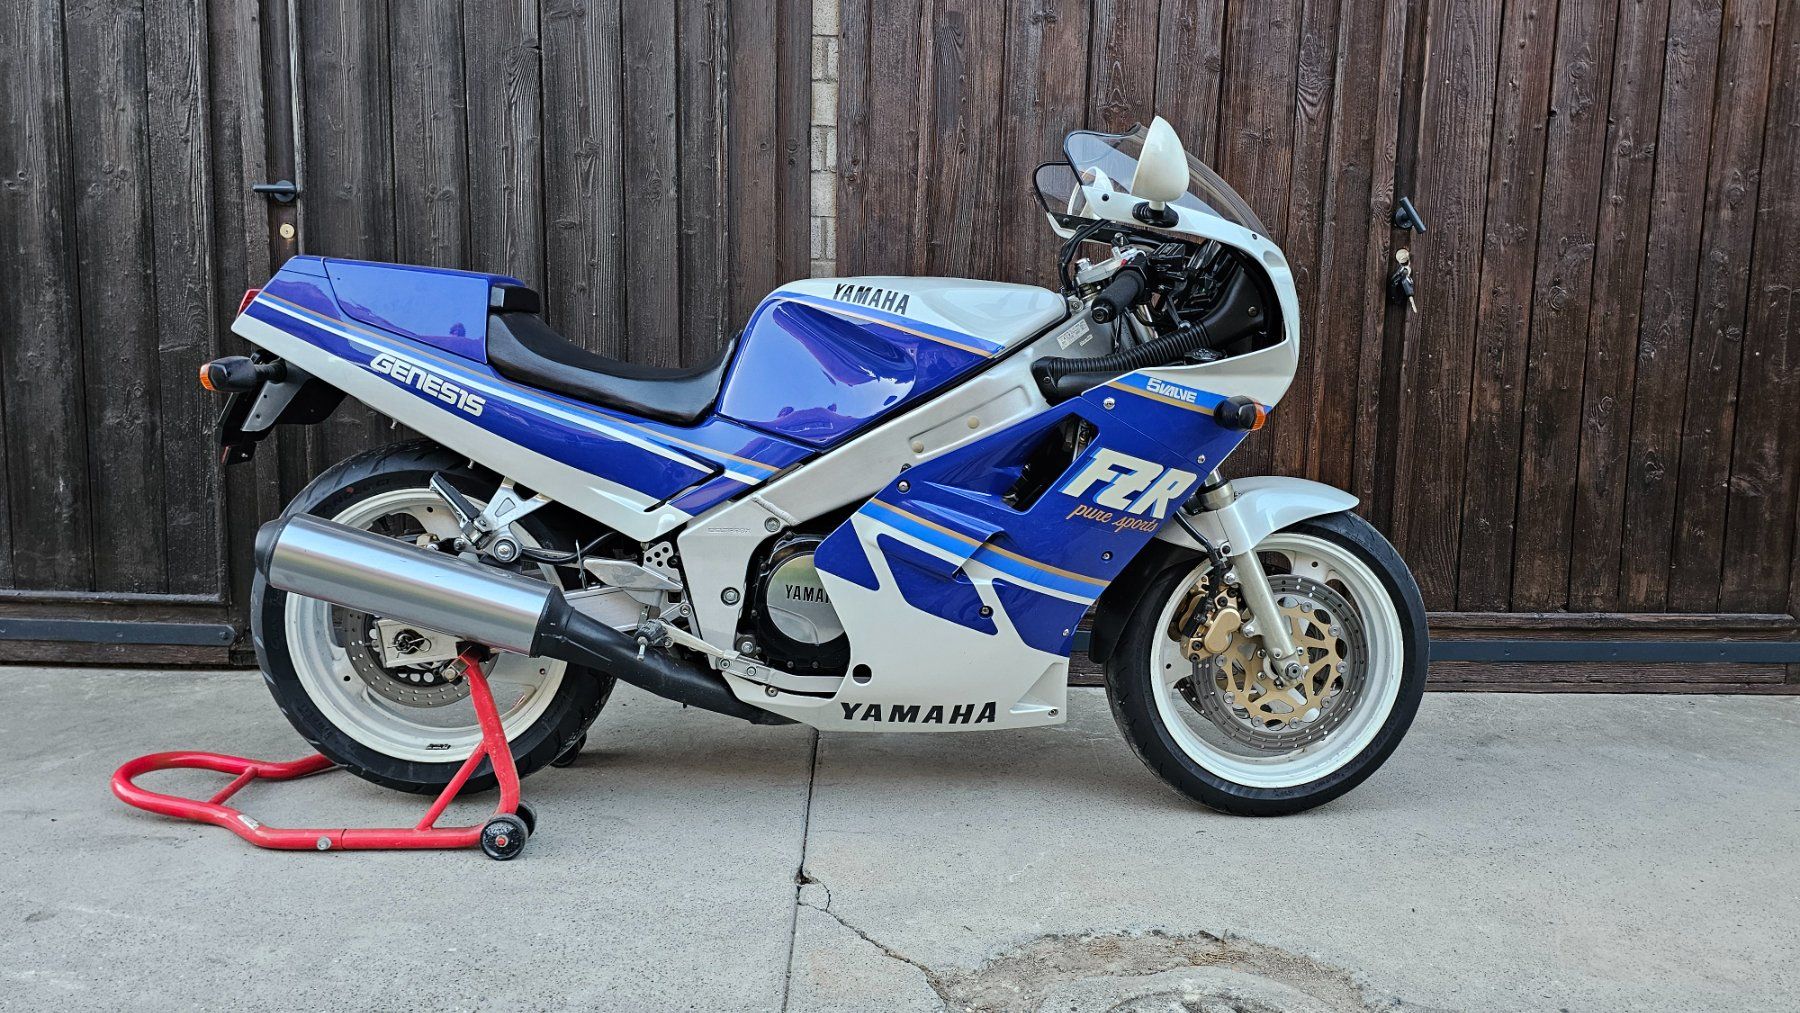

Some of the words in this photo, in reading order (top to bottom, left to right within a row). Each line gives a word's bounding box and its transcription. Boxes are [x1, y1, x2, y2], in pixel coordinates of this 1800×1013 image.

[833, 283, 910, 315] YAMAHA
[370, 353, 486, 417] GENESIS
[1058, 447, 1197, 519] FZR
[1066, 504, 1113, 520] pure
[1112, 516, 1158, 533] sports
[841, 701, 996, 724] YAMAHA
